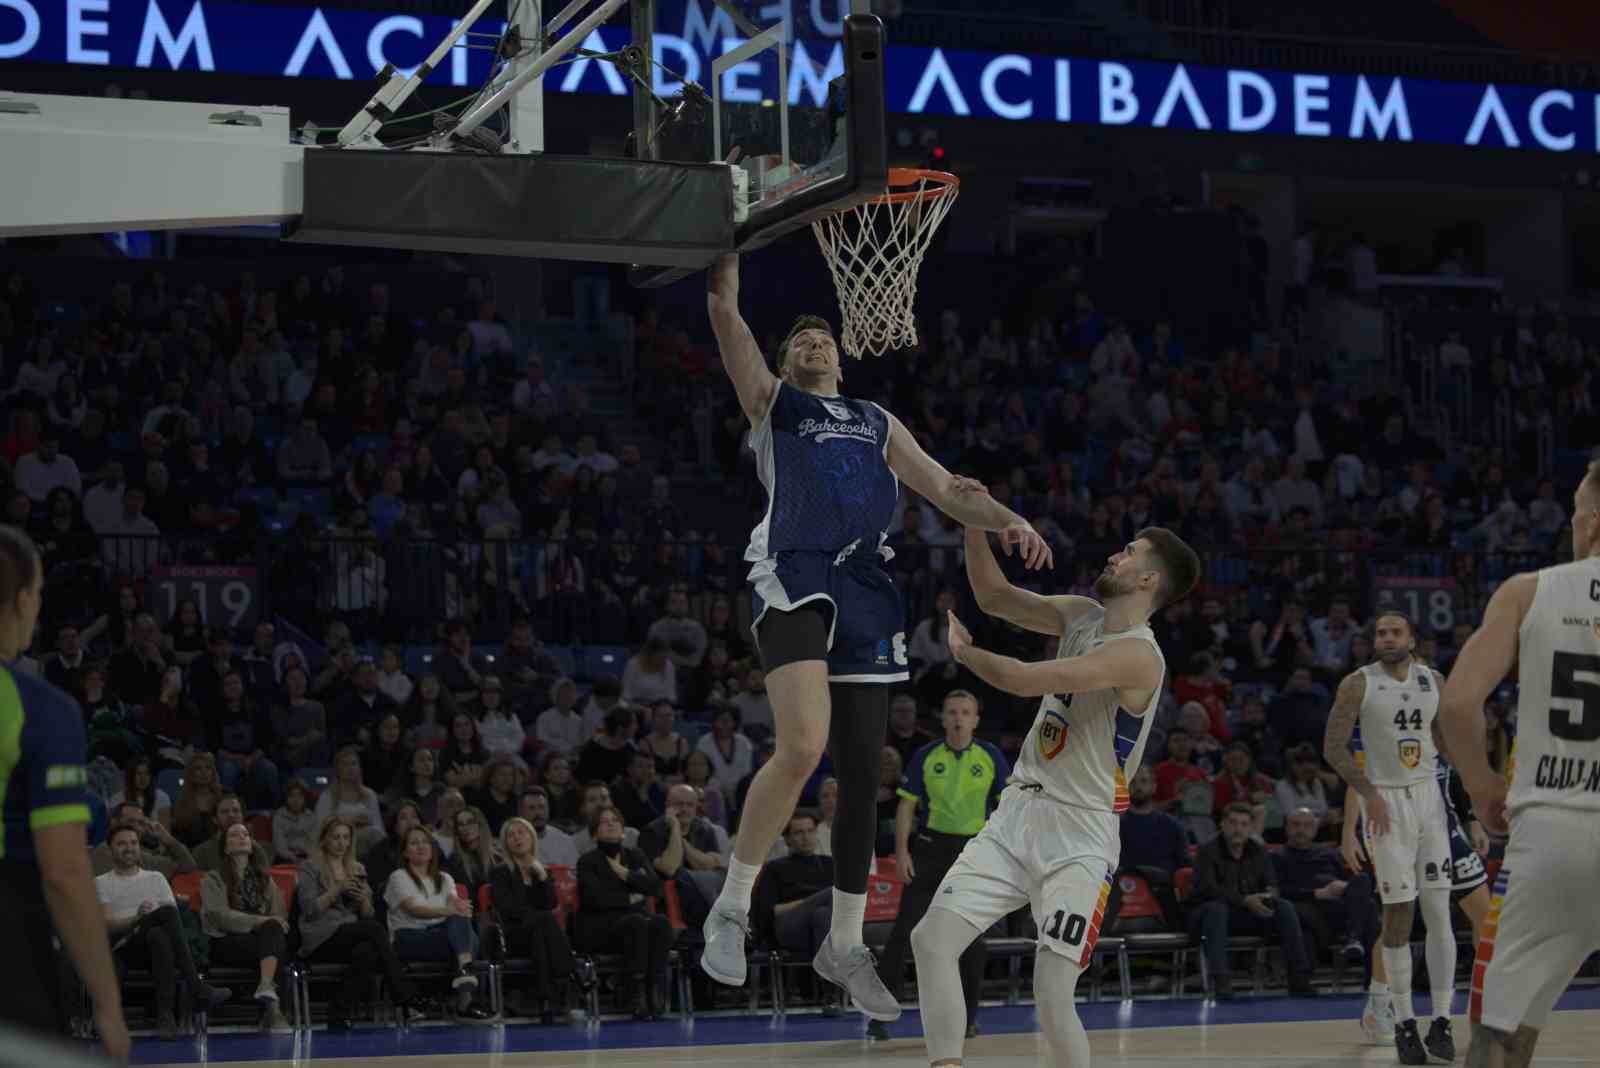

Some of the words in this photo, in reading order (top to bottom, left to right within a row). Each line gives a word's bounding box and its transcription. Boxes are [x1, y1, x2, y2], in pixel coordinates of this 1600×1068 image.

[907, 46, 1414, 142] ACIBADEM
[160, 580, 252, 628] 119
[1393, 708, 1423, 731] 44
[1549, 650, 1600, 741] 5
[1046, 909, 1087, 946] 10
